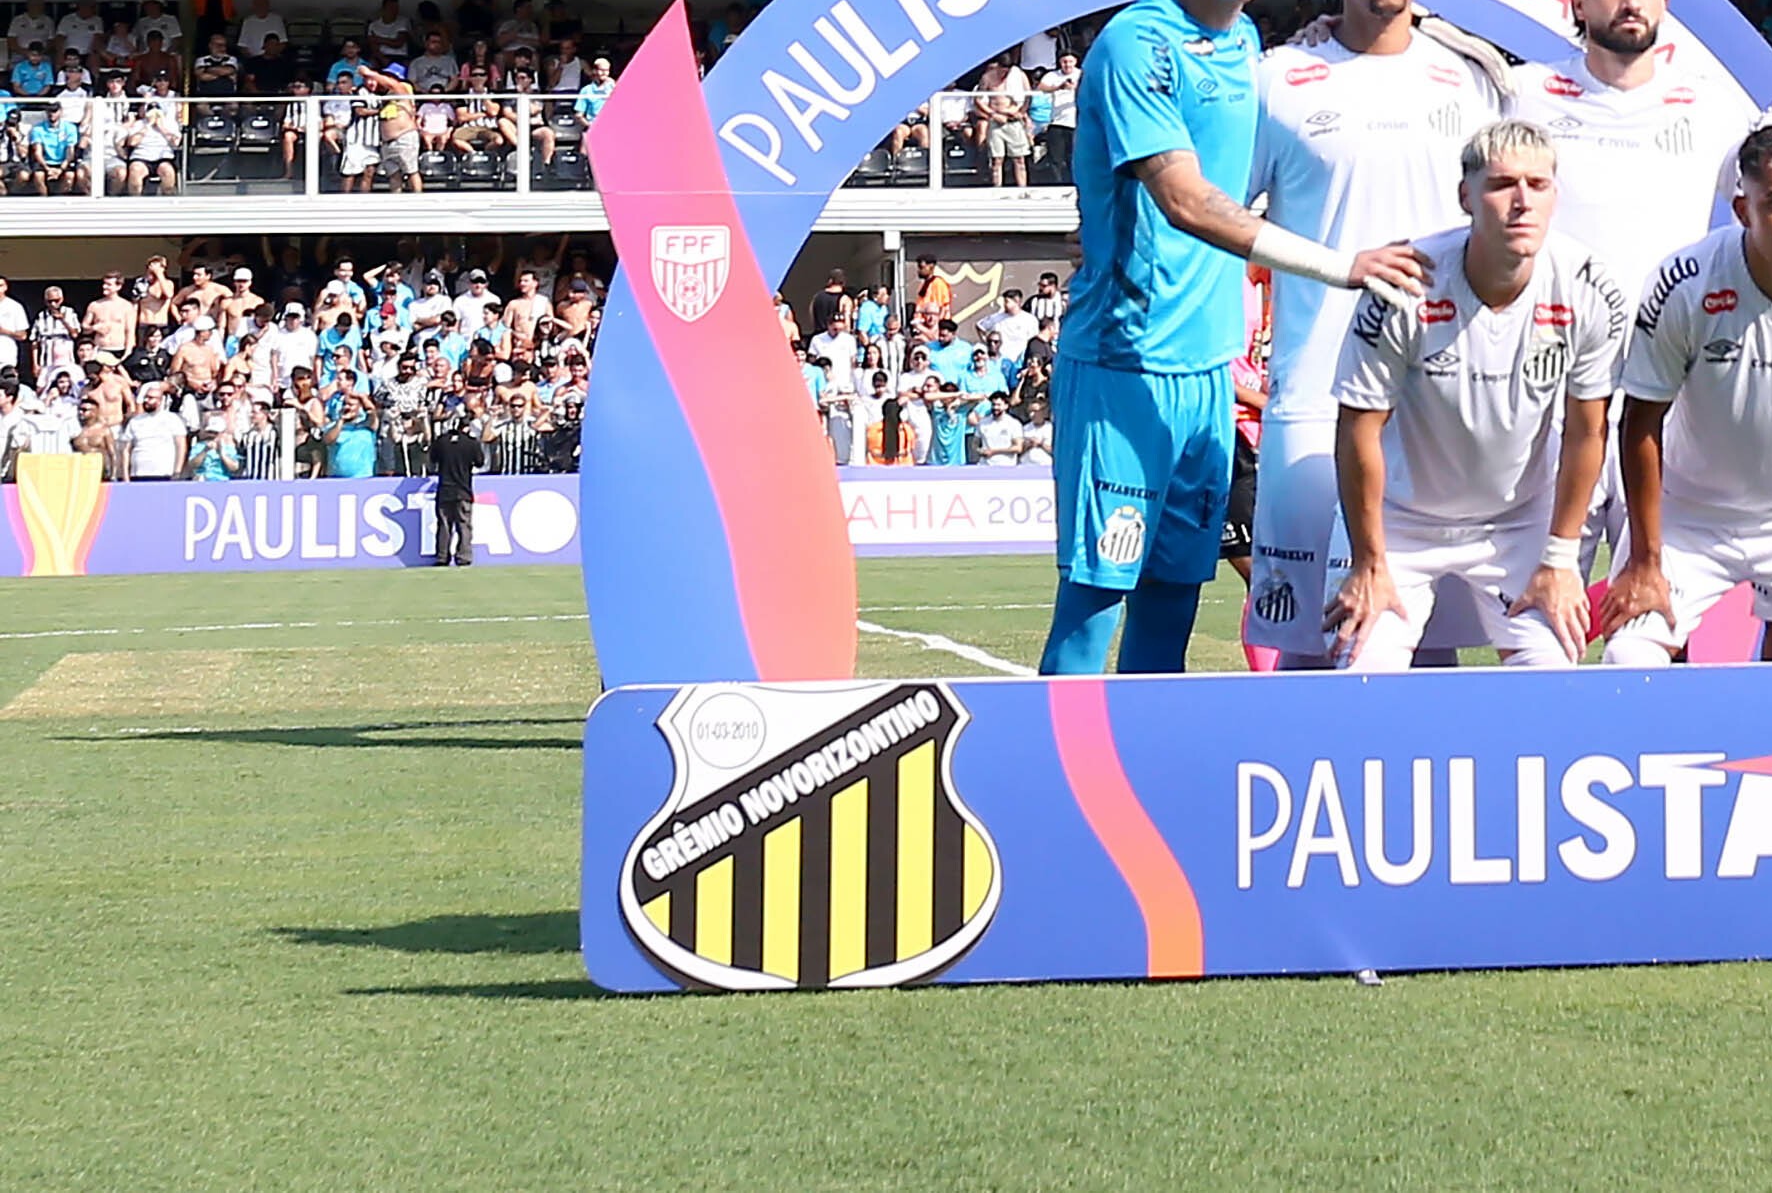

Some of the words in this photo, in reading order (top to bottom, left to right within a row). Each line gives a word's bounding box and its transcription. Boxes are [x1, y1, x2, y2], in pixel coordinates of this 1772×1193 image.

[666, 234, 716, 255] FPF
[641, 800, 745, 882] GRÊMIO
[739, 689, 941, 826] NOVORIZONTINO
